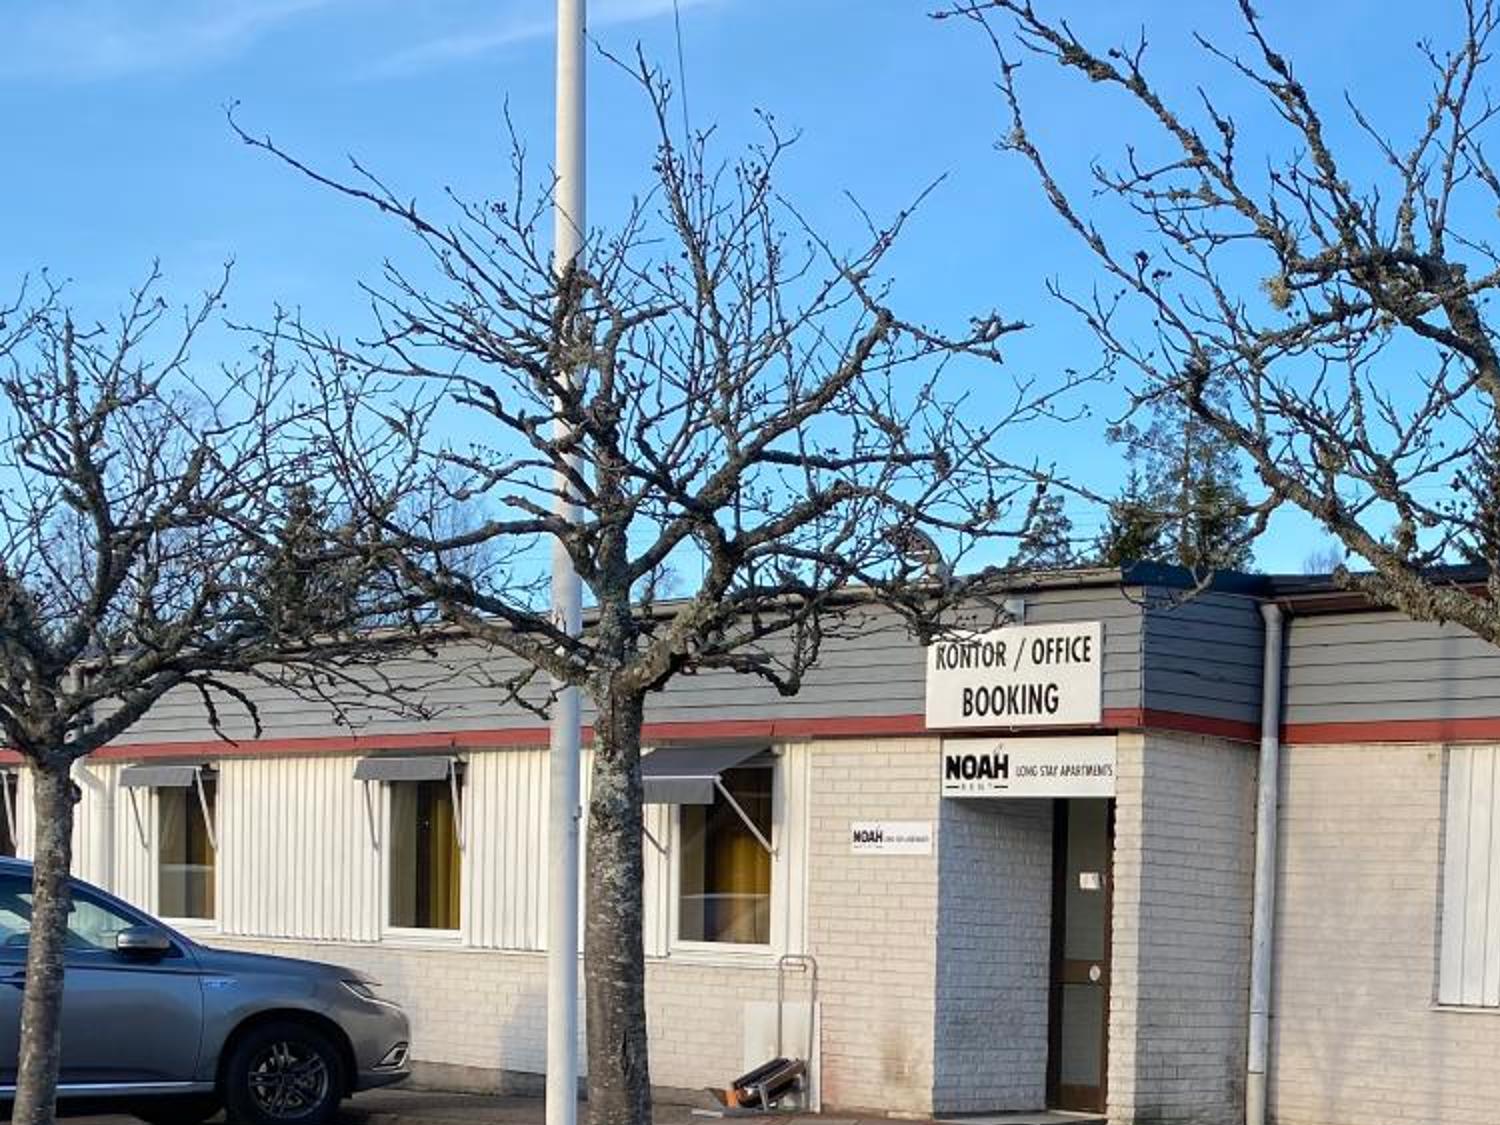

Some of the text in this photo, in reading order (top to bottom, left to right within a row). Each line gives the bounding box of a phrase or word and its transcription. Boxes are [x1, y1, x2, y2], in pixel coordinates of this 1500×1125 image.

[936, 636, 1091, 672] KONTOR / OFFICE
[963, 683, 1059, 717] BOOKING
[946, 754, 1008, 780] NOAH
[1016, 764, 1112, 777] LONG STAY APARTMENTS
[853, 830, 883, 843] NOAH
